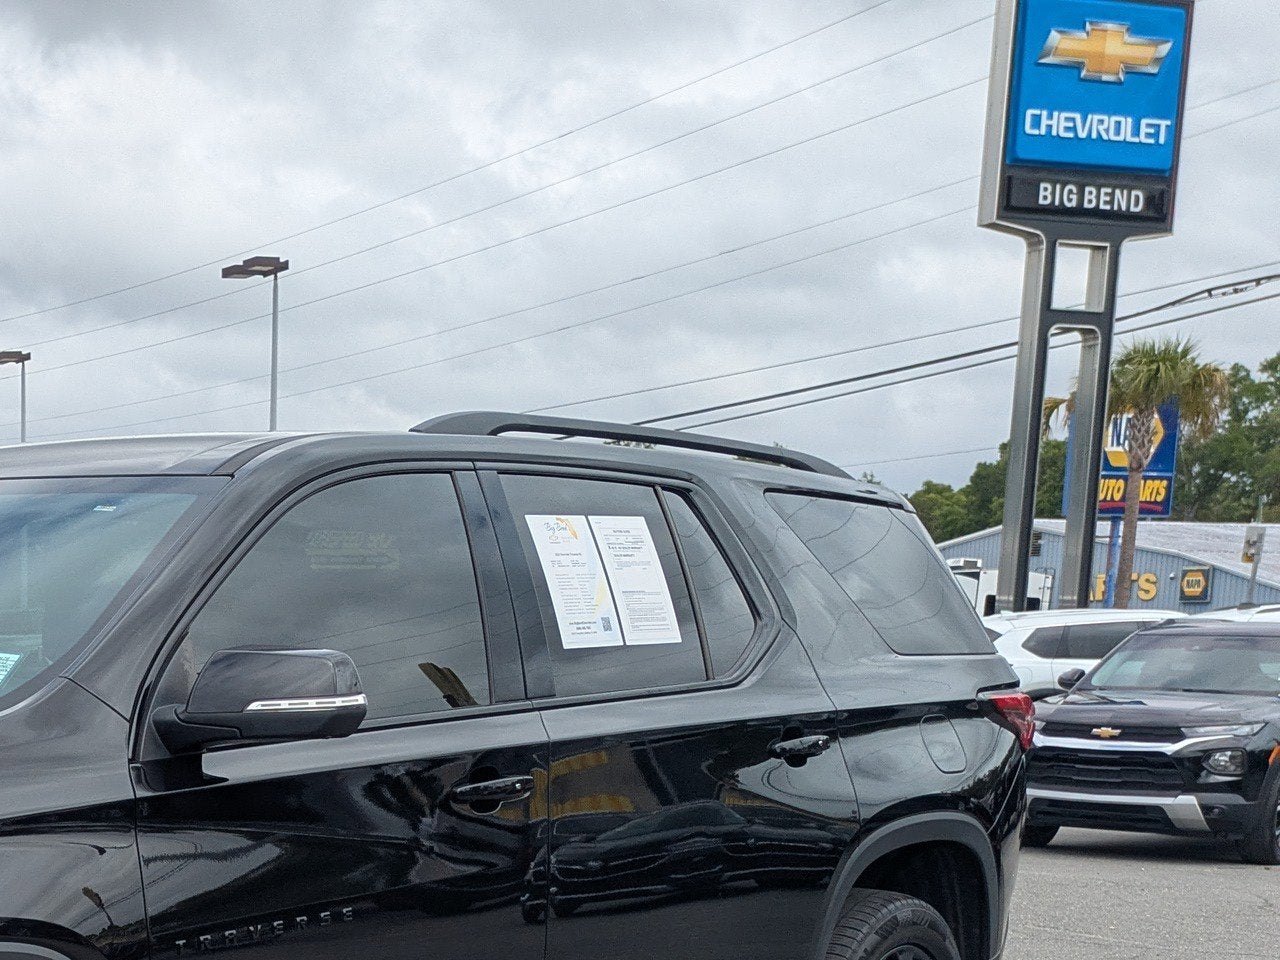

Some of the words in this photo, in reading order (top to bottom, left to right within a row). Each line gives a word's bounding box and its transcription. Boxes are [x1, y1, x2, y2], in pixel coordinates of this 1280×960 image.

[1024, 109, 1171, 145] CHEVROLET
[1038, 181, 1077, 208] BIG
[1083, 185, 1144, 213] BEND
[1099, 478, 1125, 501] UTO
[1139, 479, 1168, 502] RTS
[175, 906, 353, 955] TRAVERSE
